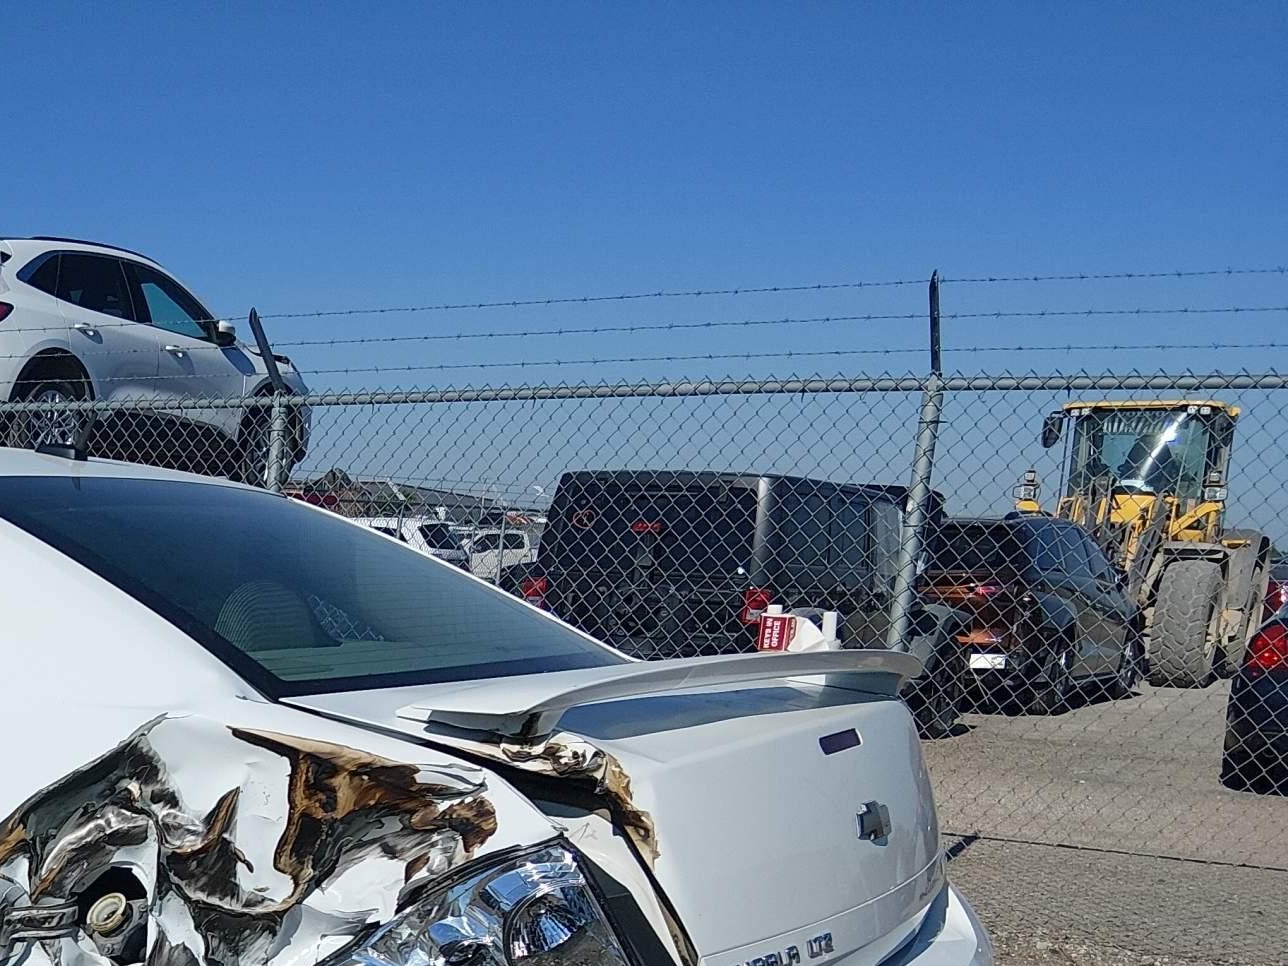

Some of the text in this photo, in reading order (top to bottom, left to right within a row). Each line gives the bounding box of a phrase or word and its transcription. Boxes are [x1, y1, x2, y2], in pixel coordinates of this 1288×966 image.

[763, 618, 774, 648] KEYS IN
[771, 620, 781, 647] OFFICE
